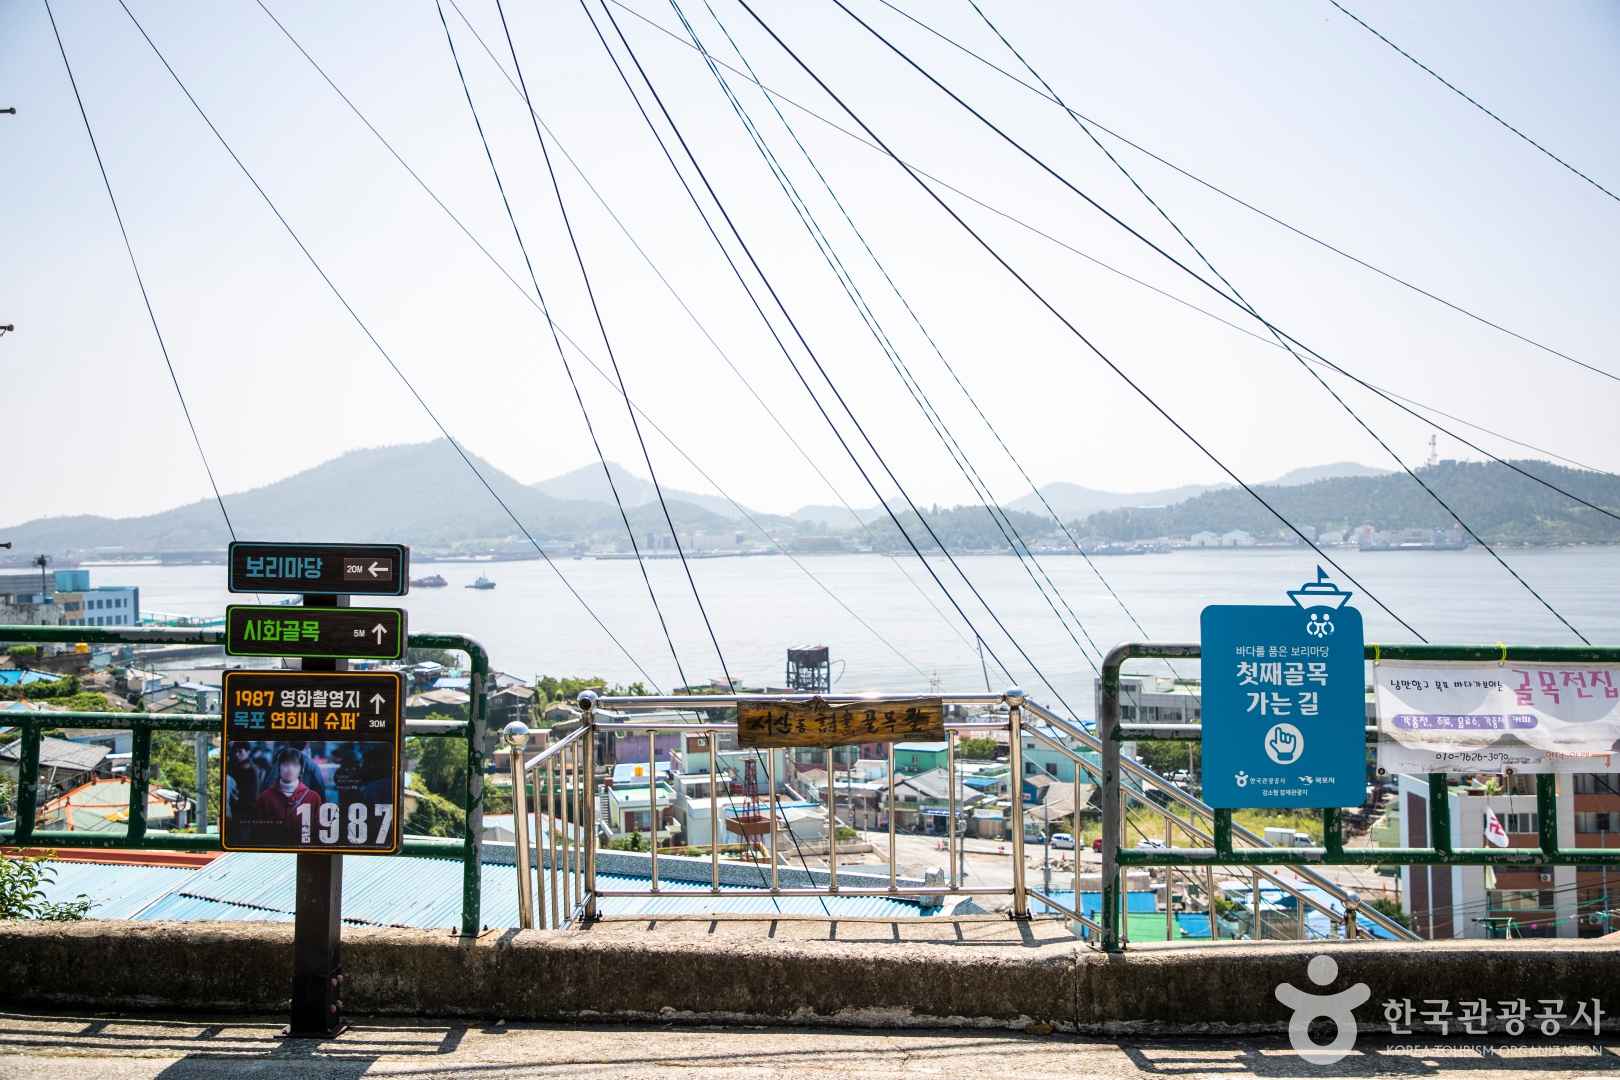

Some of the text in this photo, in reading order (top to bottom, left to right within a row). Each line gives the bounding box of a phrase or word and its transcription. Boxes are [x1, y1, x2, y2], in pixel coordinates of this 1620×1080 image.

[246, 556, 363, 578] 보리마당 20M
[243, 619, 366, 642] 시화골목 5M
[1236, 645, 1329, 657] 바다를 품은 보리마당
[1236, 661, 1329, 686] 첫째골목
[1512, 669, 1619, 706] 골목전집
[235, 690, 360, 709] 1987 영화촬영지
[1246, 692, 1319, 716] 가는 길
[233, 711, 266, 729] 목포
[271, 711, 319, 730] 연희네
[368, 720, 386, 728] 30M
[296, 802, 394, 844] 1987
